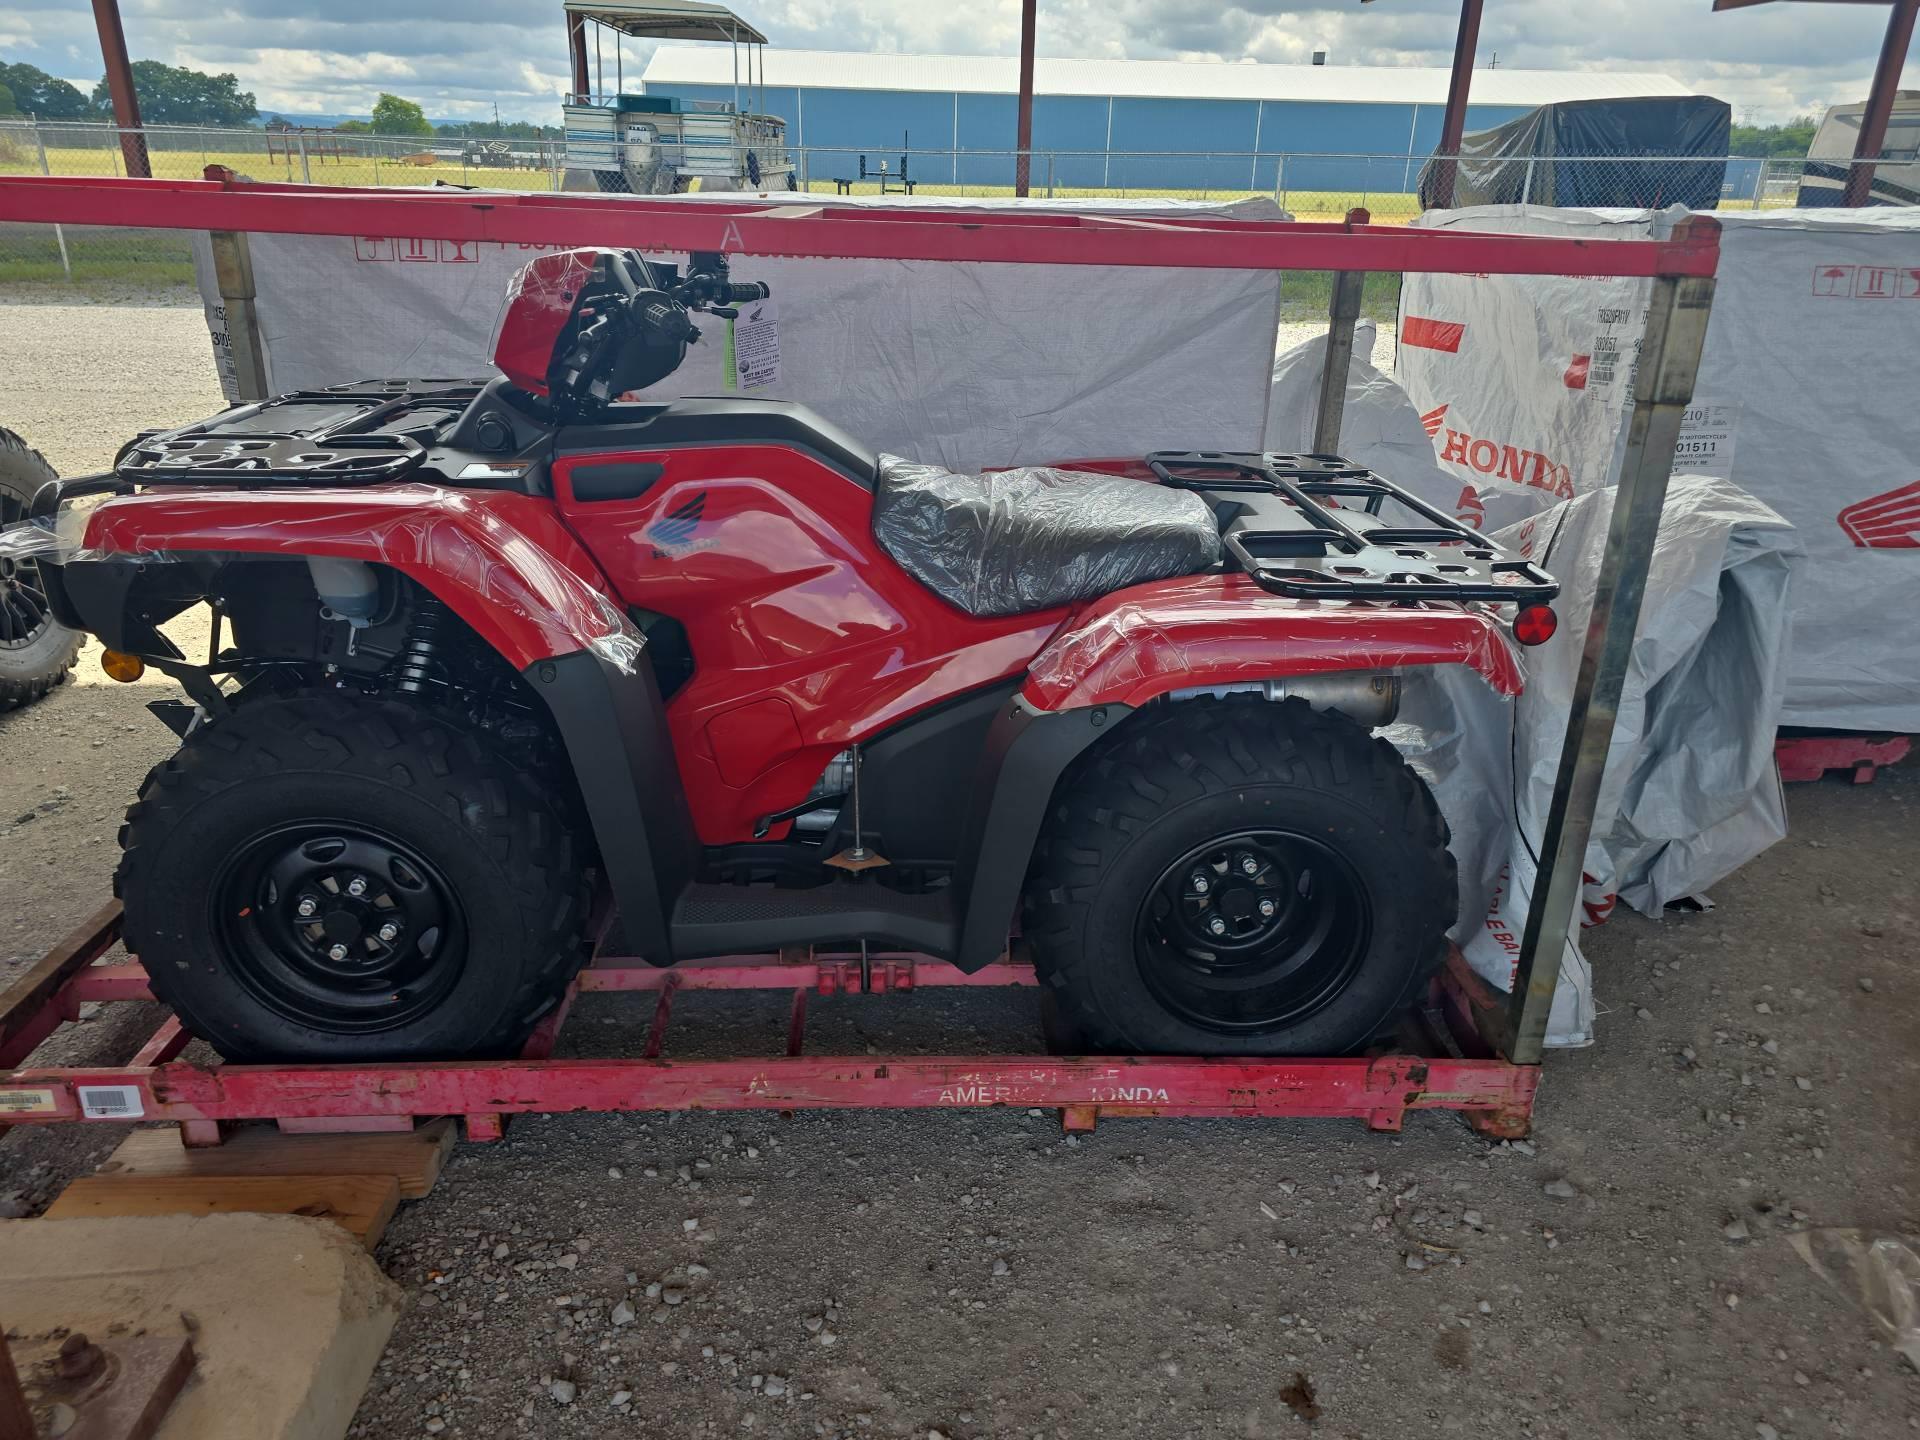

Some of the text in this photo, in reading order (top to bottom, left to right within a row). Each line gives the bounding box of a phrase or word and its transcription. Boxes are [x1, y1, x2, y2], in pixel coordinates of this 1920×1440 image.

[720, 220, 744, 249] A
[1676, 442, 1716, 453] 01511
[1440, 428, 1575, 500] HONDA
